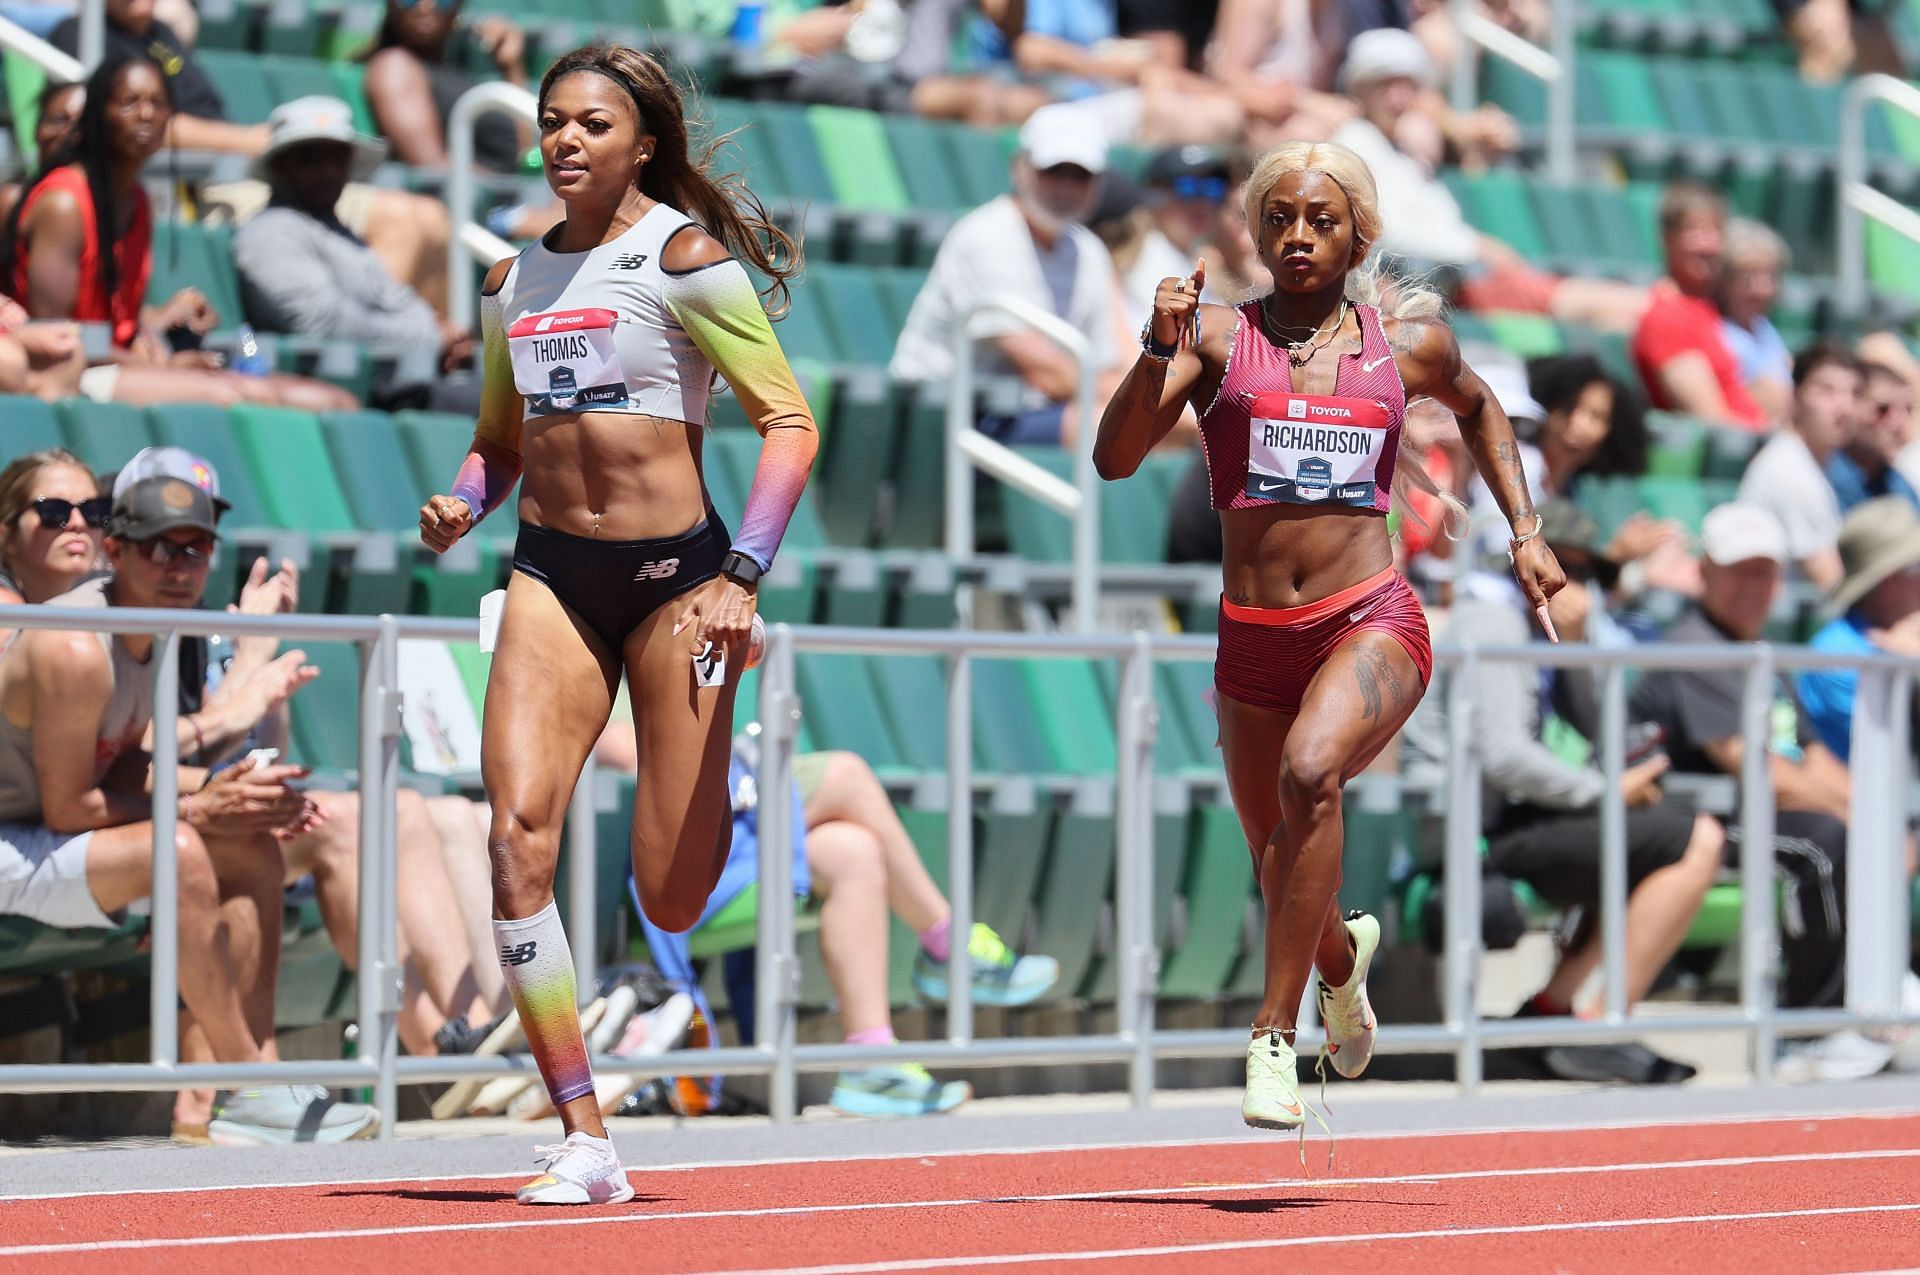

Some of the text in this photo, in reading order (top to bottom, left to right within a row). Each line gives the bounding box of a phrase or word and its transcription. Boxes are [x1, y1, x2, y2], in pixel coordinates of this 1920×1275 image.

[553, 315, 584, 325] TOYOTA
[532, 334, 588, 364] THOMAS
[593, 391, 616, 400] USATF
[1309, 405, 1352, 418] TOYOTA
[1262, 424, 1372, 456] RICHARDSON
[1345, 490, 1366, 498] USATF
